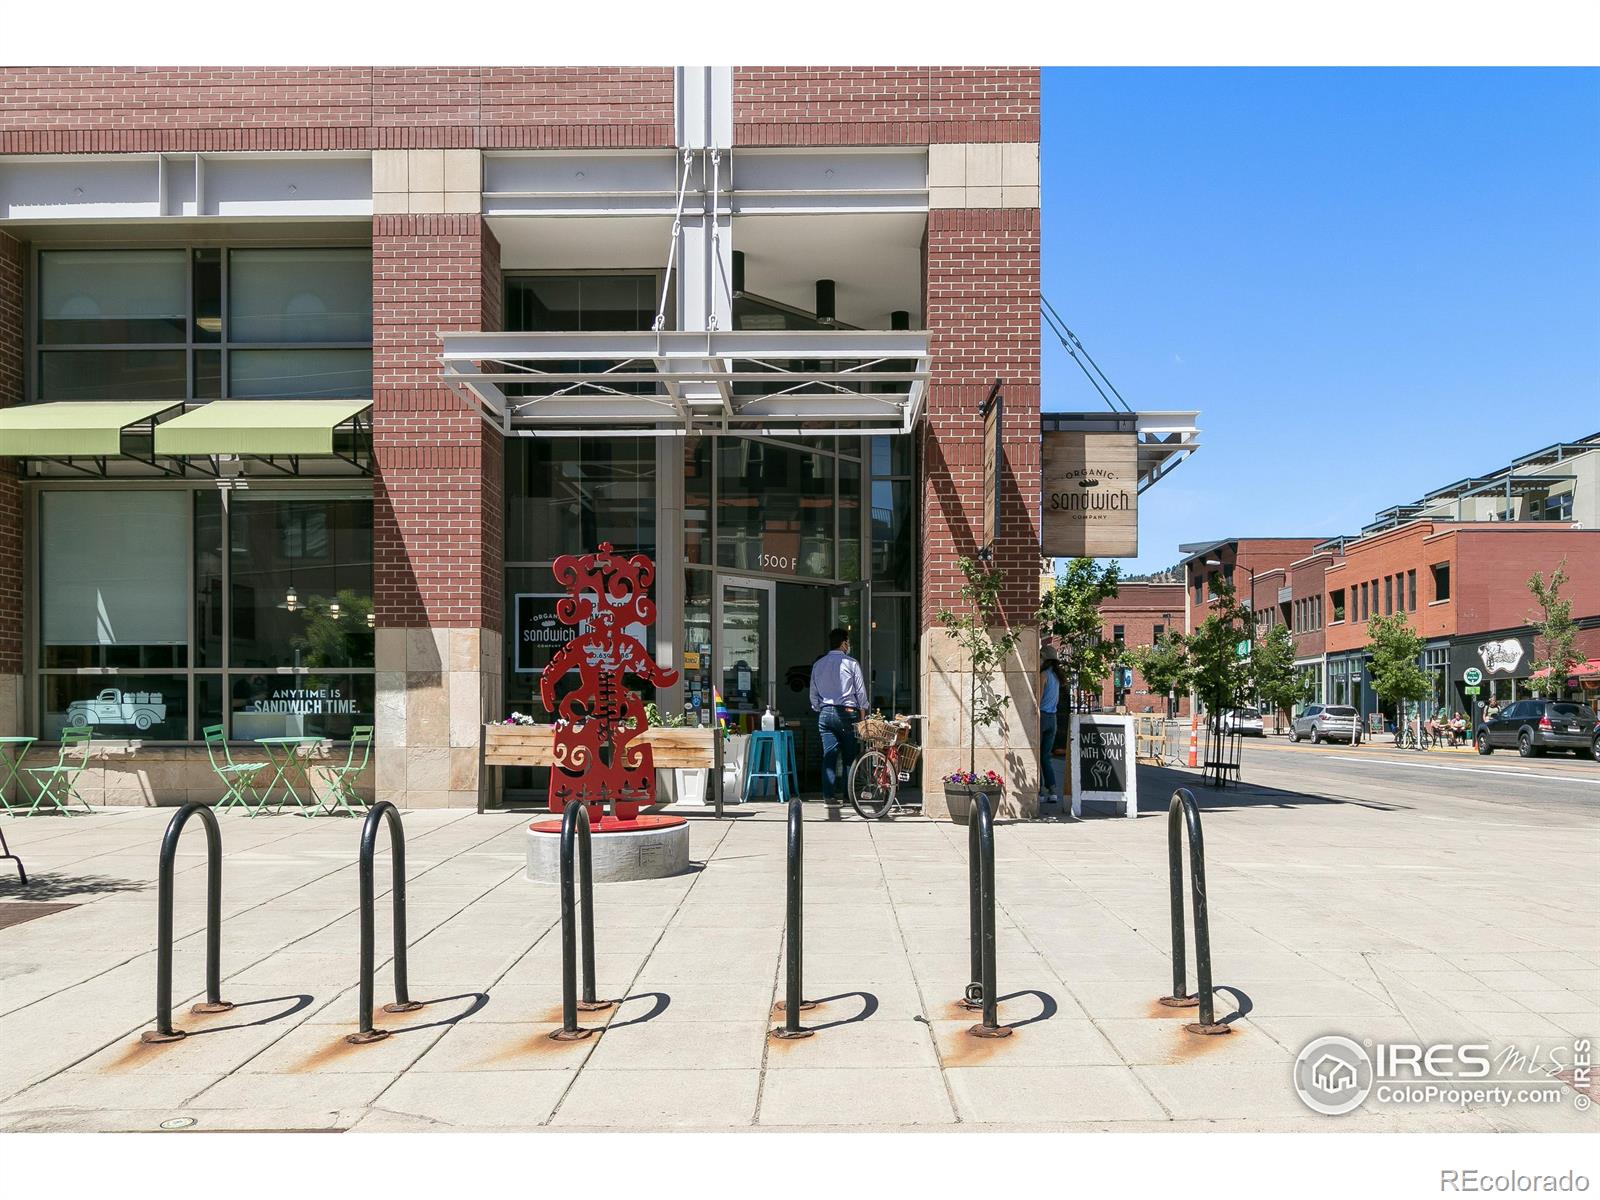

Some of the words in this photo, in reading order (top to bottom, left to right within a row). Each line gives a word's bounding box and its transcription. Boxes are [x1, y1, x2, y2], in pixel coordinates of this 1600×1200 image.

[1065, 469, 1115, 479] ORGANIC
[1051, 490, 1129, 510] sandwich
[757, 554, 787, 569] 1500
[791, 557, 797, 570] F
[523, 626, 576, 642] sandwich
[272, 689, 327, 698] ANYTIME
[330, 689, 341, 698] IS
[254, 699, 322, 714] SANDWICH
[326, 699, 361, 713] TIME.
[1081, 733, 1097, 744] WE
[1099, 732, 1126, 747] STAND
[1080, 747, 1099, 760] WITH
[1101, 748, 1123, 760] YOU!
